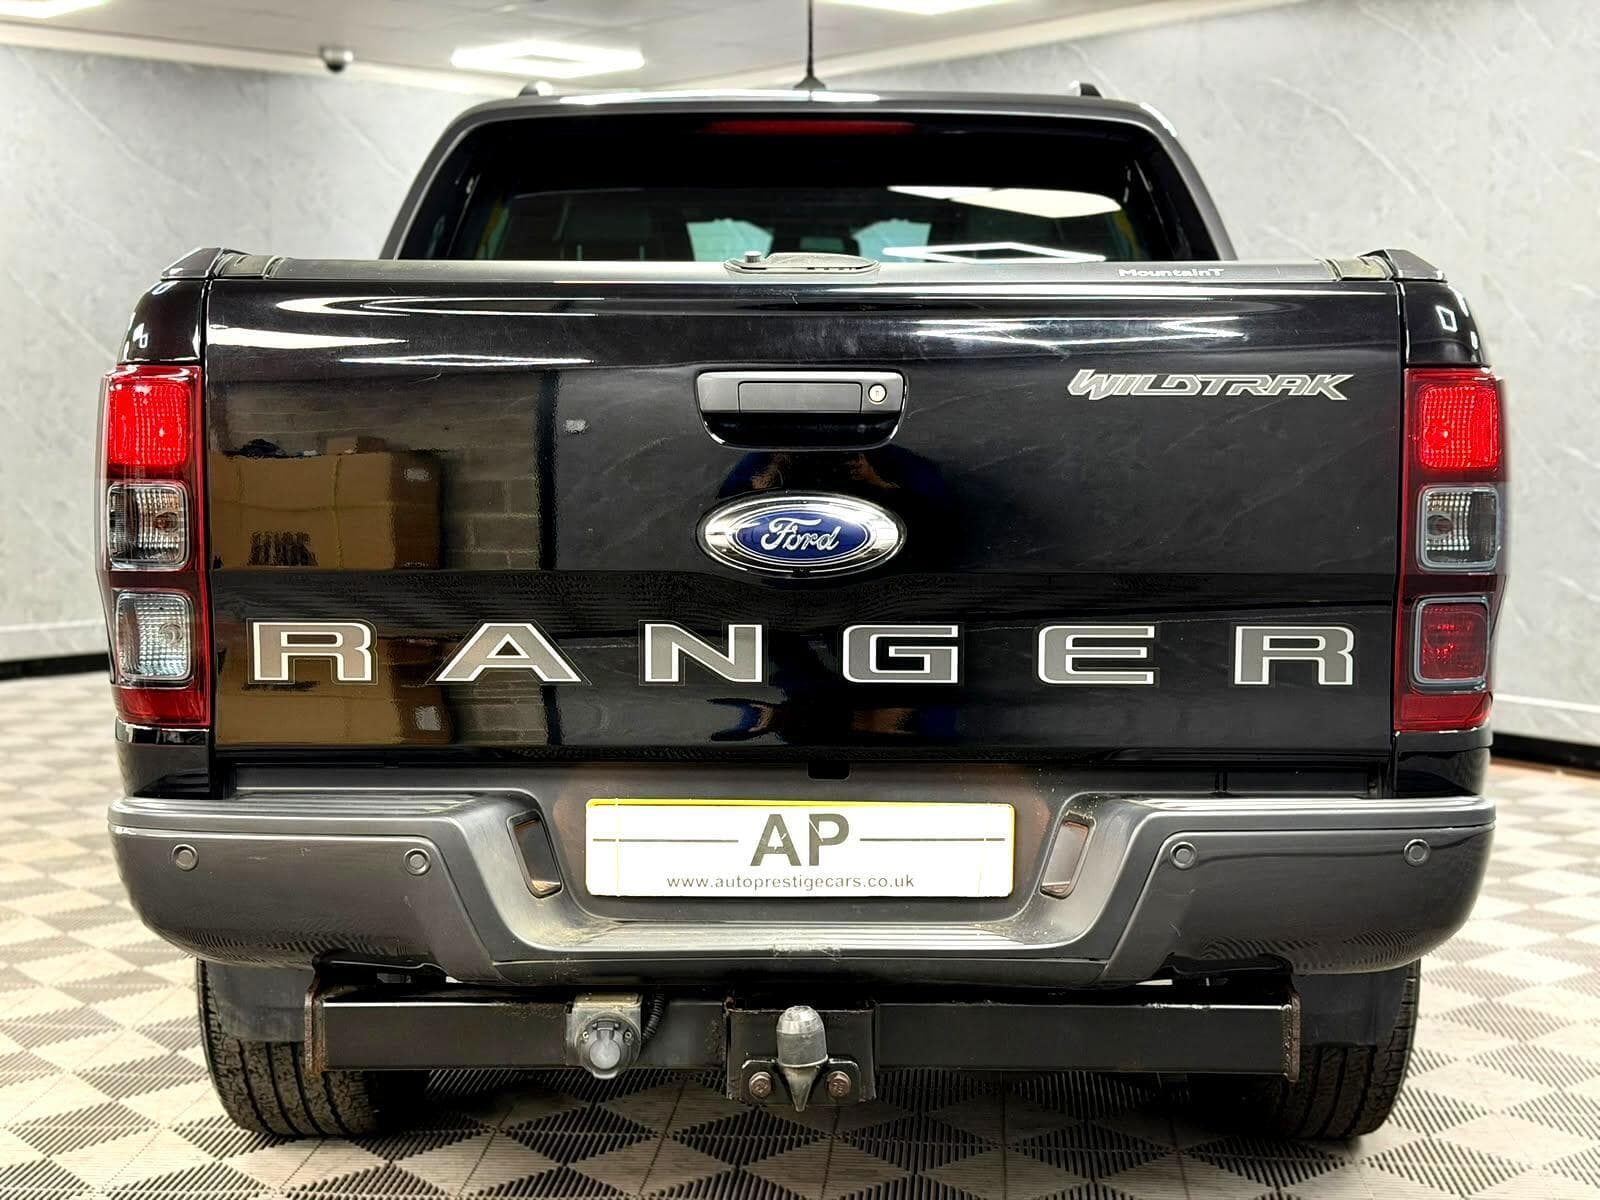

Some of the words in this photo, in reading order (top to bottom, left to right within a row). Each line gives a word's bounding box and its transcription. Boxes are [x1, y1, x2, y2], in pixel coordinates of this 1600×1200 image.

[1066, 368, 1354, 400] WILDTRAK
[760, 517, 842, 551] Ford
[251, 621, 1355, 686] RANGER
[749, 813, 850, 867] AP
[666, 873, 915, 892] www.autoprestigecars.co.uk
